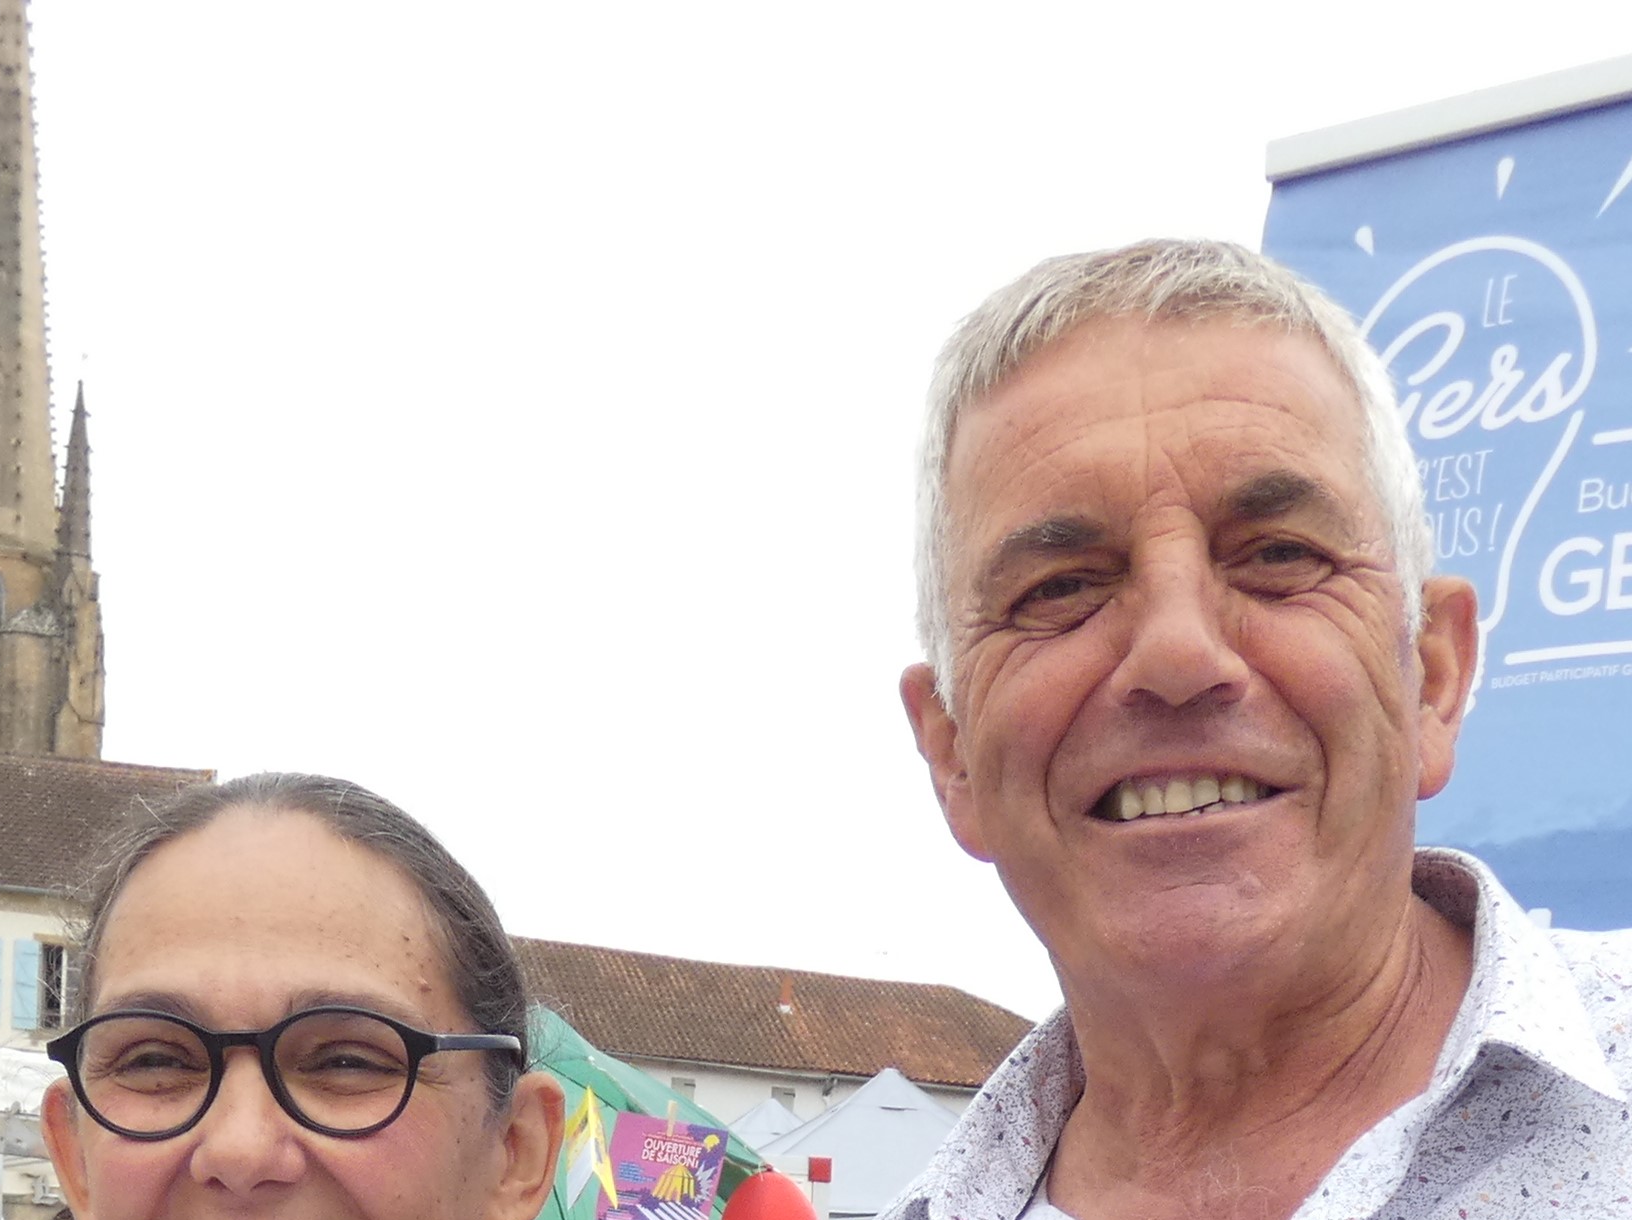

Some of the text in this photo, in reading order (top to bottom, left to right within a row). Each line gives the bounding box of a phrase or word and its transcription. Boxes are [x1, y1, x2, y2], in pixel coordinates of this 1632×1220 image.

[1481, 273, 1518, 327] LE
[1491, 672, 1537, 689] BUDGET
[1540, 664, 1620, 683] PARTICIPATIF
